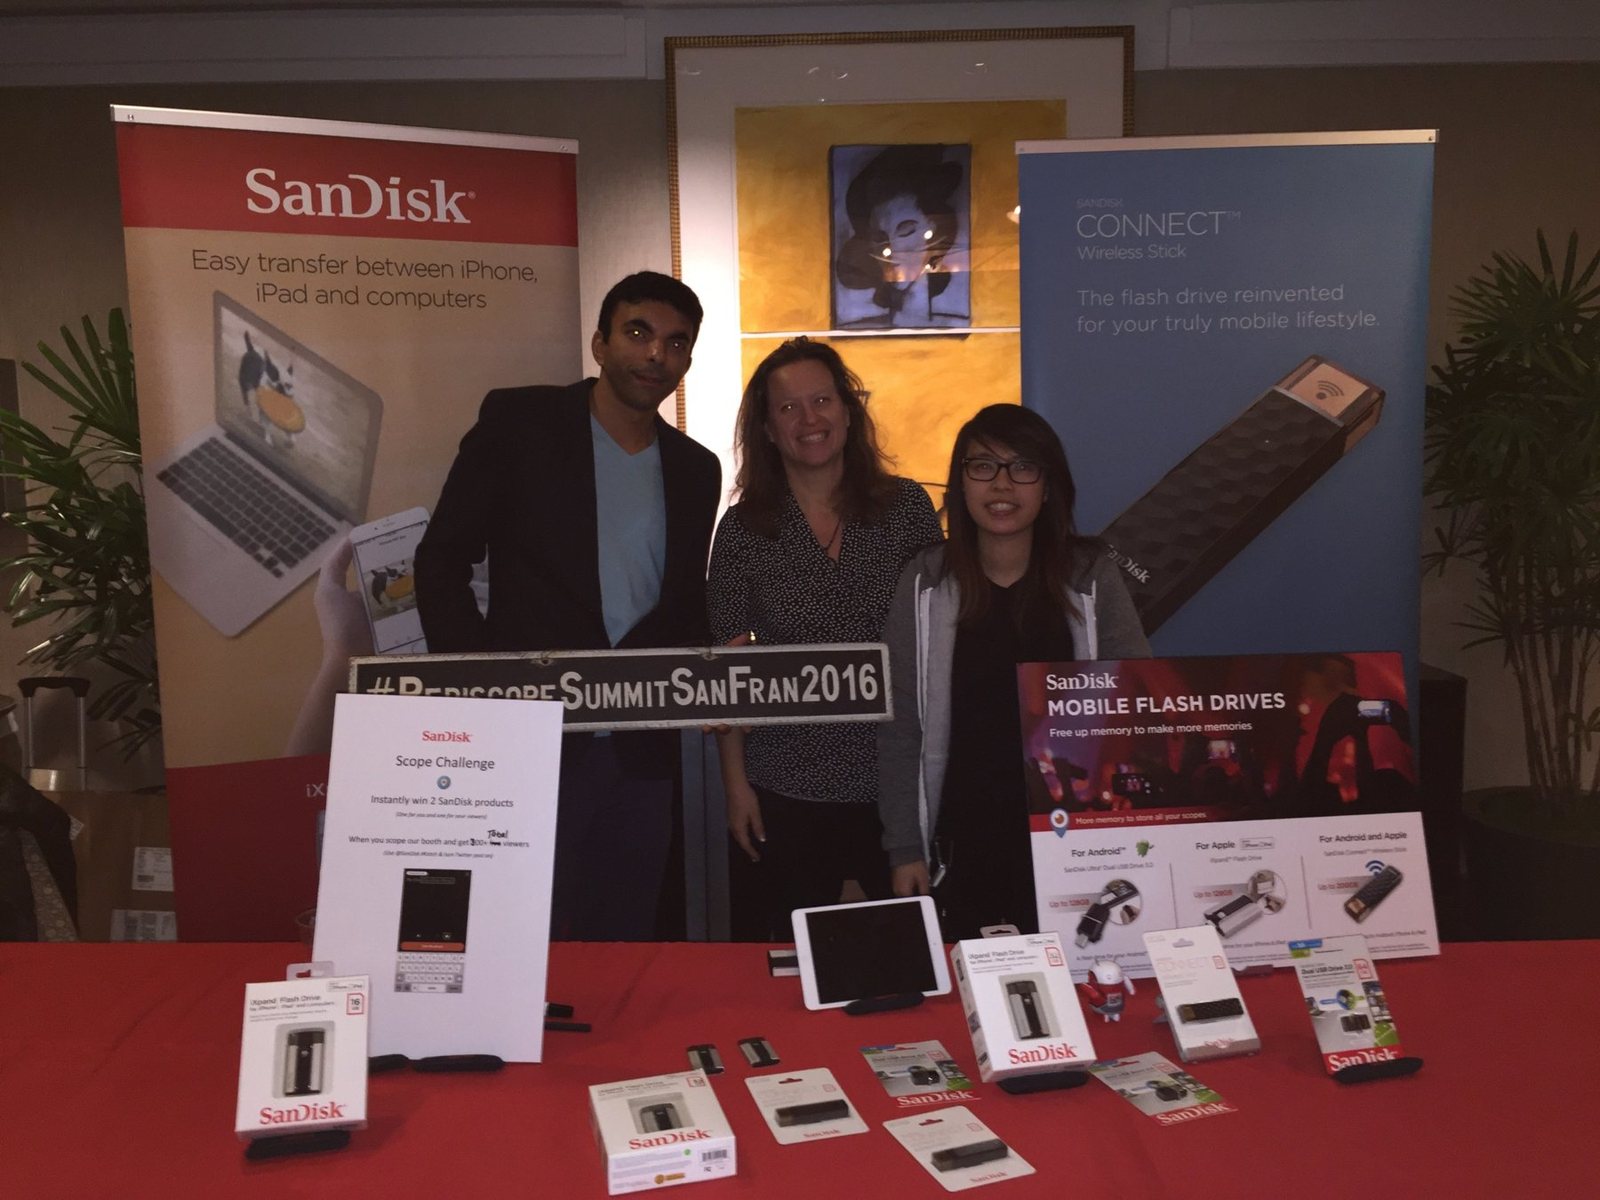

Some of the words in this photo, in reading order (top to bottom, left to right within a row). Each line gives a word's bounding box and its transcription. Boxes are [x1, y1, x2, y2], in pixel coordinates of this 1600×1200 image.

[1077, 245, 1144, 261] Wireless
[1147, 243, 1187, 259] Stick
[192, 249, 250, 275] Easy
[257, 253, 349, 275] transfer
[355, 255, 454, 278] between
[460, 259, 538, 283] iPhone,
[256, 282, 308, 304] iPad
[315, 285, 359, 305] and
[366, 289, 488, 311] computers
[1077, 289, 1114, 306] The
[1121, 287, 1169, 306] flash
[1176, 287, 1228, 305] drive
[1234, 284, 1345, 303] reinvented
[1077, 315, 1105, 333] for
[1111, 318, 1158, 336] your
[1165, 313, 1213, 334] truly
[1219, 312, 1289, 330] mobile
[1296, 309, 1380, 330] lifestyle.
[1046, 672, 1118, 691] SanDisk
[1047, 697, 1130, 717] MOBILE
[1135, 695, 1204, 714] FLASH
[1209, 692, 1287, 711] DRIVES
[422, 731, 472, 743] SanDisk
[1049, 728, 1073, 738] Free
[1075, 729, 1089, 738] up
[1090, 726, 1132, 737] memory
[1134, 725, 1145, 734] to
[1147, 724, 1175, 734] make
[1176, 724, 1202, 732] more
[1204, 721, 1253, 731] memories
[396, 755, 432, 769] Scope
[435, 756, 496, 771] Challenge
[371, 795, 410, 807] Instantly
[412, 796, 429, 805] win
[430, 796, 436, 806] 2
[438, 797, 473, 807] SanDisk
[474, 798, 514, 809] products
[1076, 817, 1094, 825] More
[1095, 815, 1125, 825] memory
[1126, 815, 1135, 823] to
[1136, 814, 1154, 822] store
[1165, 813, 1180, 822] your
[349, 835, 369, 844] When
[371, 837, 385, 846] you
[385, 838, 406, 847] scope
[407, 838, 420, 846] our
[421, 837, 442, 846] booth
[444, 838, 456, 846] and
[458, 840, 469, 848] get
[503, 840, 530, 848] viewers
[1195, 842, 1210, 850] For
[1213, 840, 1236, 850] Apple
[1319, 835, 1333, 843] For
[1335, 832, 1366, 842] Android
[1368, 832, 1382, 841] and
[1384, 831, 1407, 841] Apple
[1071, 849, 1086, 858] For
[351, 998, 360, 1006] 16
[1008, 1043, 1077, 1065] SanDisk
[898, 1090, 974, 1106] SanDisk
[259, 1101, 344, 1125] SanDisk
[1155, 1102, 1229, 1125] SanDisk
[628, 1129, 712, 1150] SanDisk
[803, 1128, 840, 1139] SanDisk
[968, 1171, 1008, 1184] SanDisk
